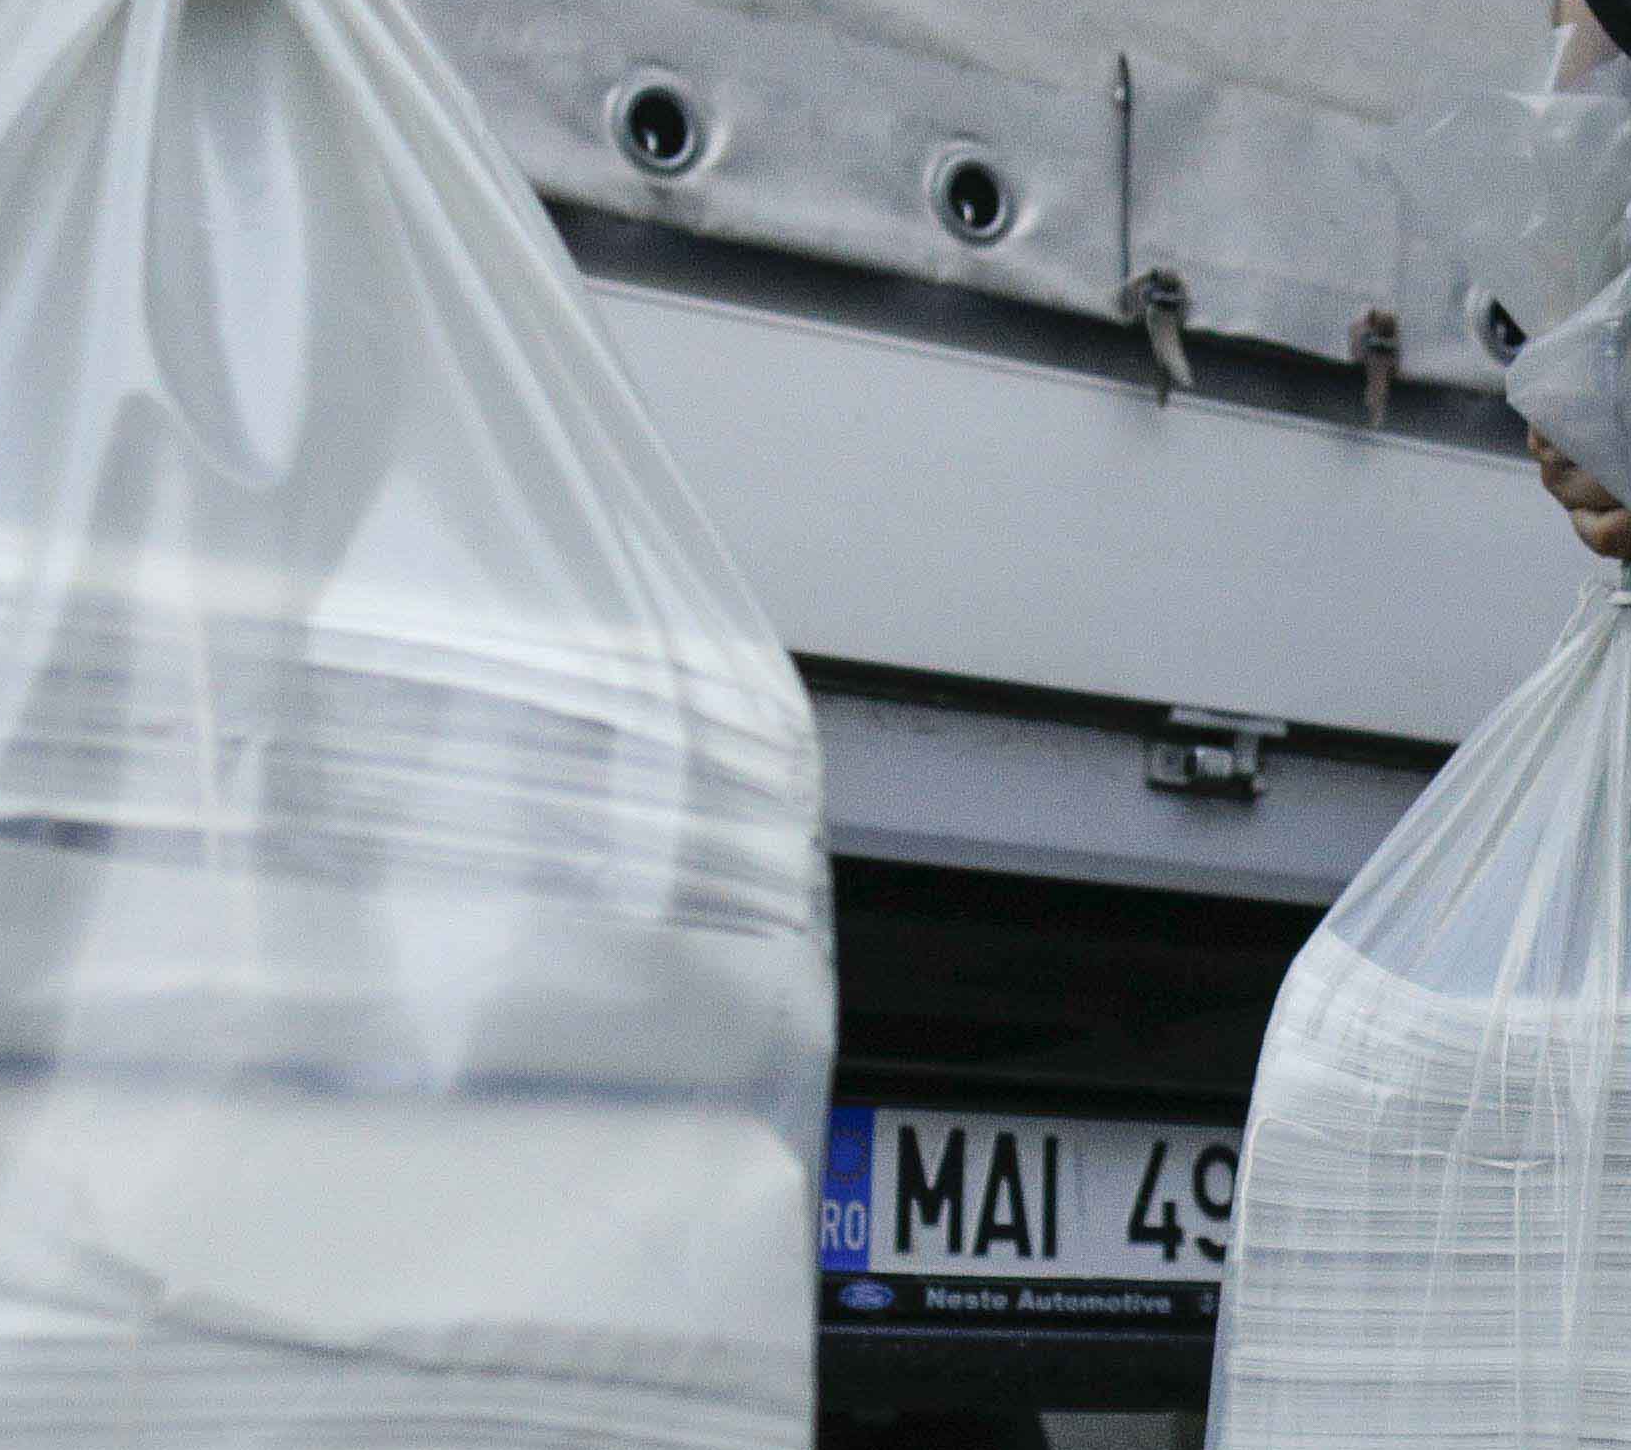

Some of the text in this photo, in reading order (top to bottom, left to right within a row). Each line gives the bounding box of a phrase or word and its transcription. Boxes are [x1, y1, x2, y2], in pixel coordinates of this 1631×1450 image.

[821, 1198, 866, 1251] RO
[894, 1124, 1239, 1264] MAI 49
